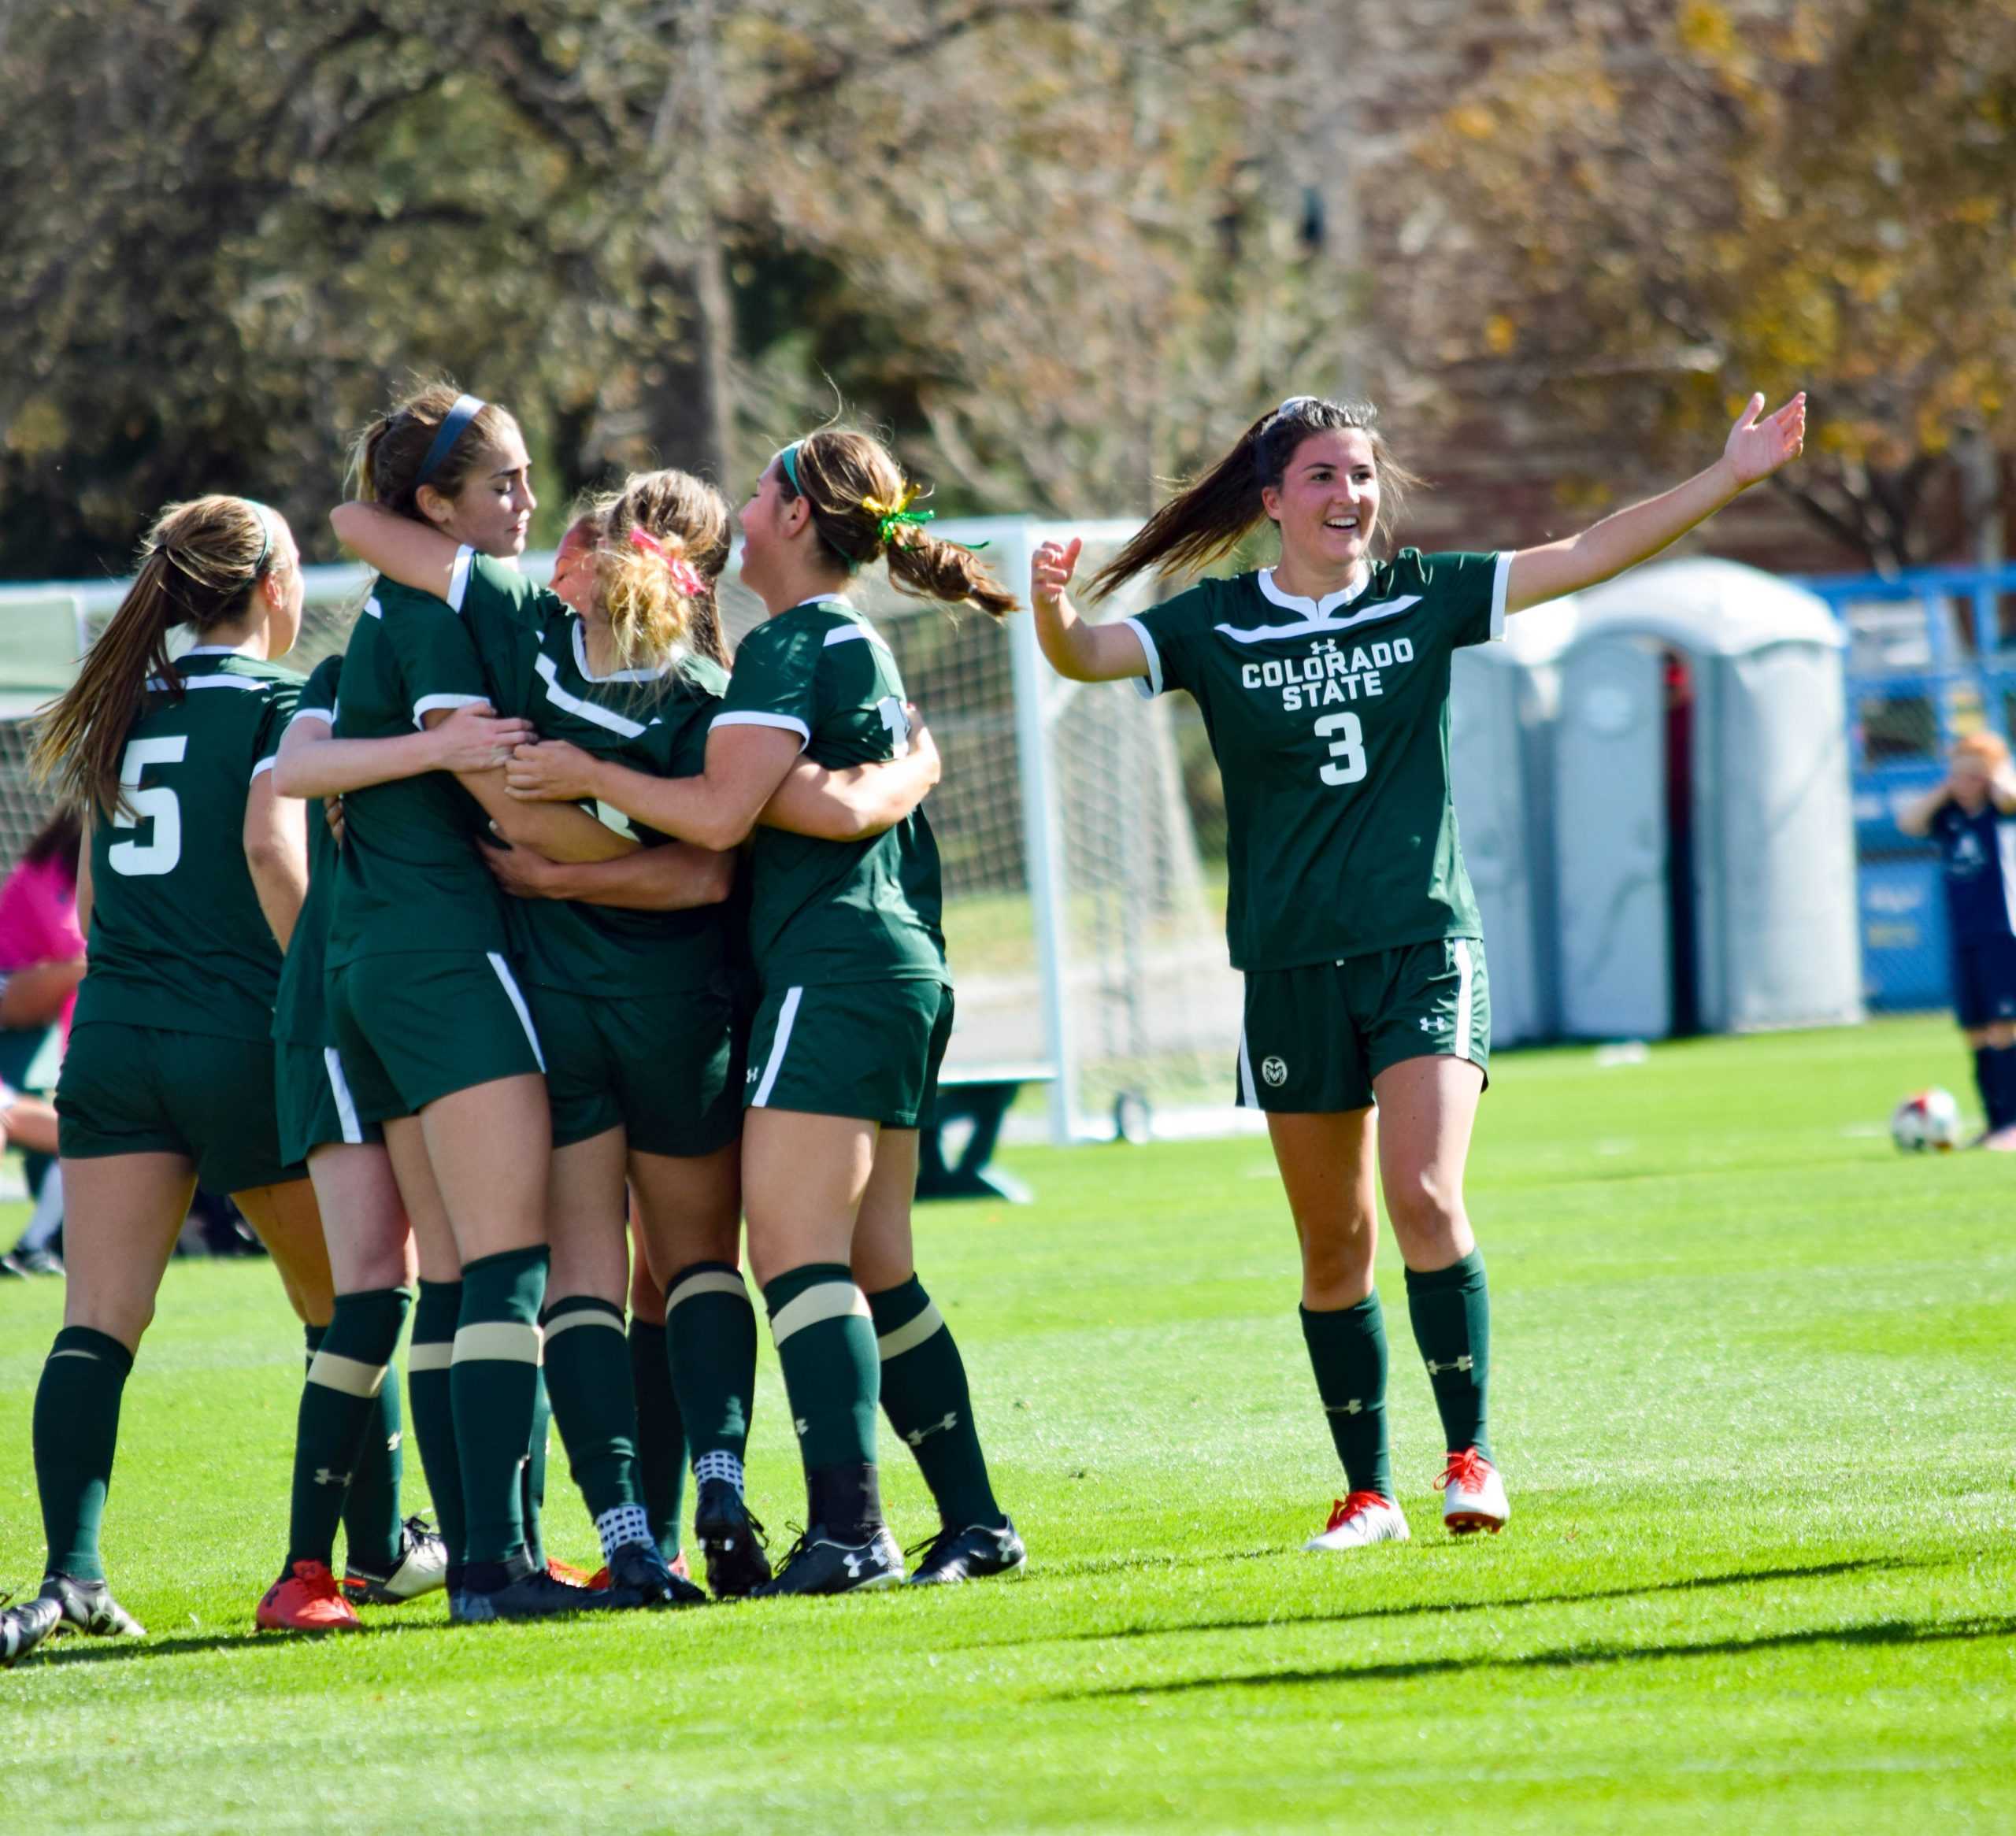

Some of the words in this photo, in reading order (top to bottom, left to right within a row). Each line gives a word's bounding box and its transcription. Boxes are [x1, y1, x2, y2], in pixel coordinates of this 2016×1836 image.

[1242, 637, 1414, 689] COLORADO
[1282, 670, 1384, 712] STATE
[1314, 711, 1368, 786] 3
[108, 735, 188, 876] 5
